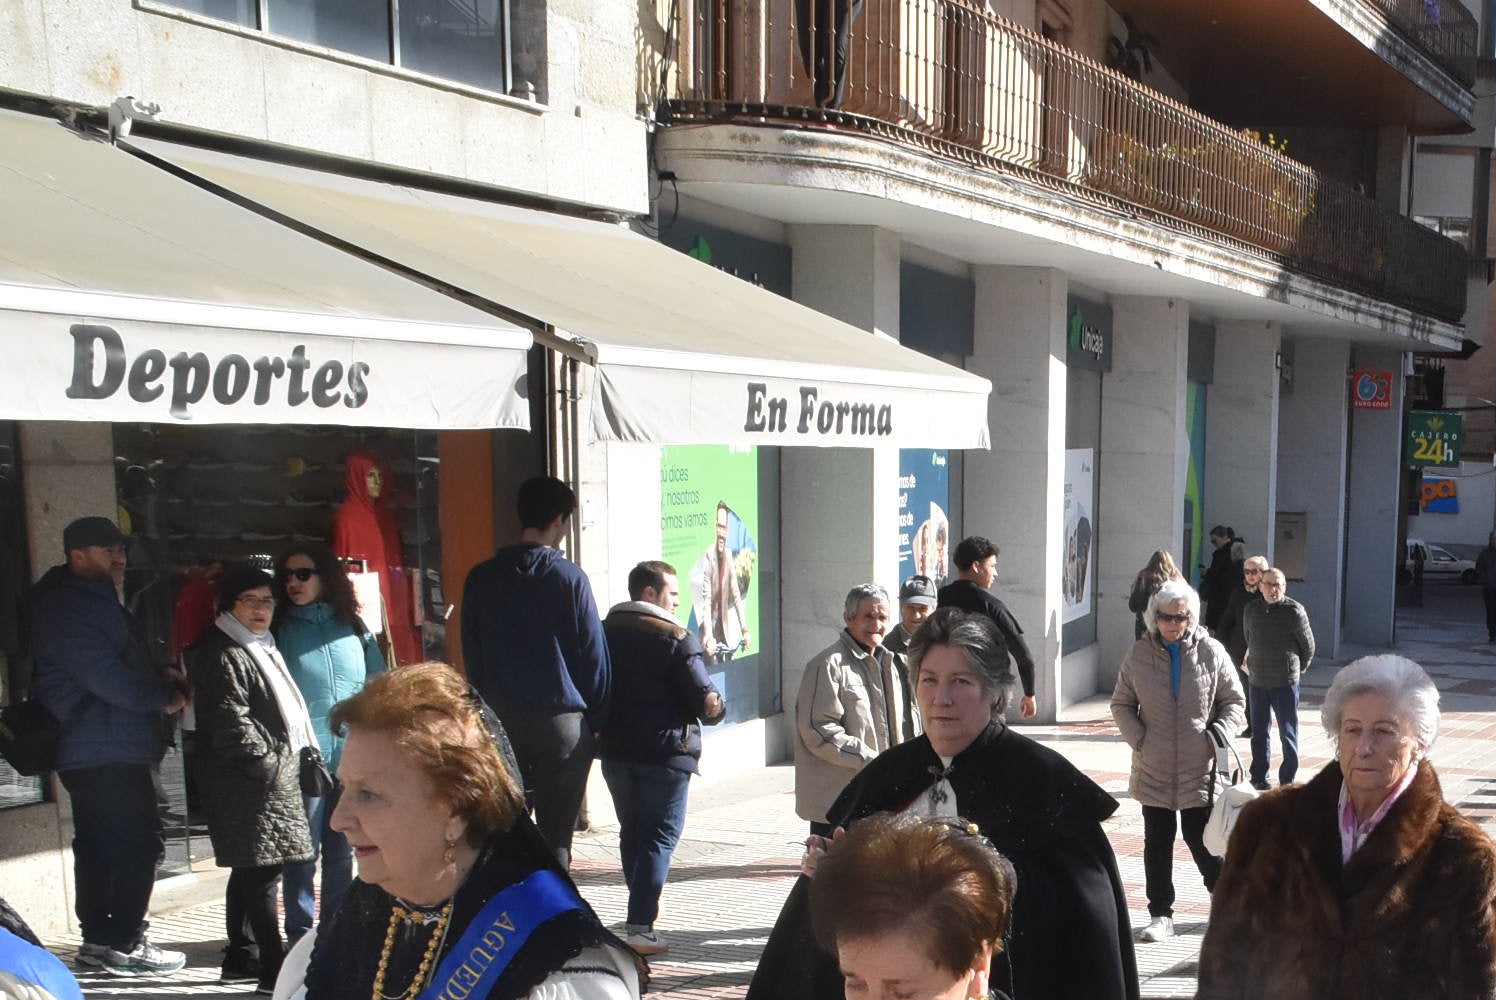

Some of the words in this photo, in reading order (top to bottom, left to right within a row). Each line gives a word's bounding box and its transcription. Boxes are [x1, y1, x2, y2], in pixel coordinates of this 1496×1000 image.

[1081, 325, 1103, 360] Unicaja
[66, 323, 370, 420] Deportes
[744, 382, 788, 433] En
[796, 386, 893, 436] Forma
[1411, 431, 1458, 441] CAJERO
[1413, 438, 1454, 464] 24h
[668, 464, 689, 482] dices
[667, 489, 700, 506] nosotros
